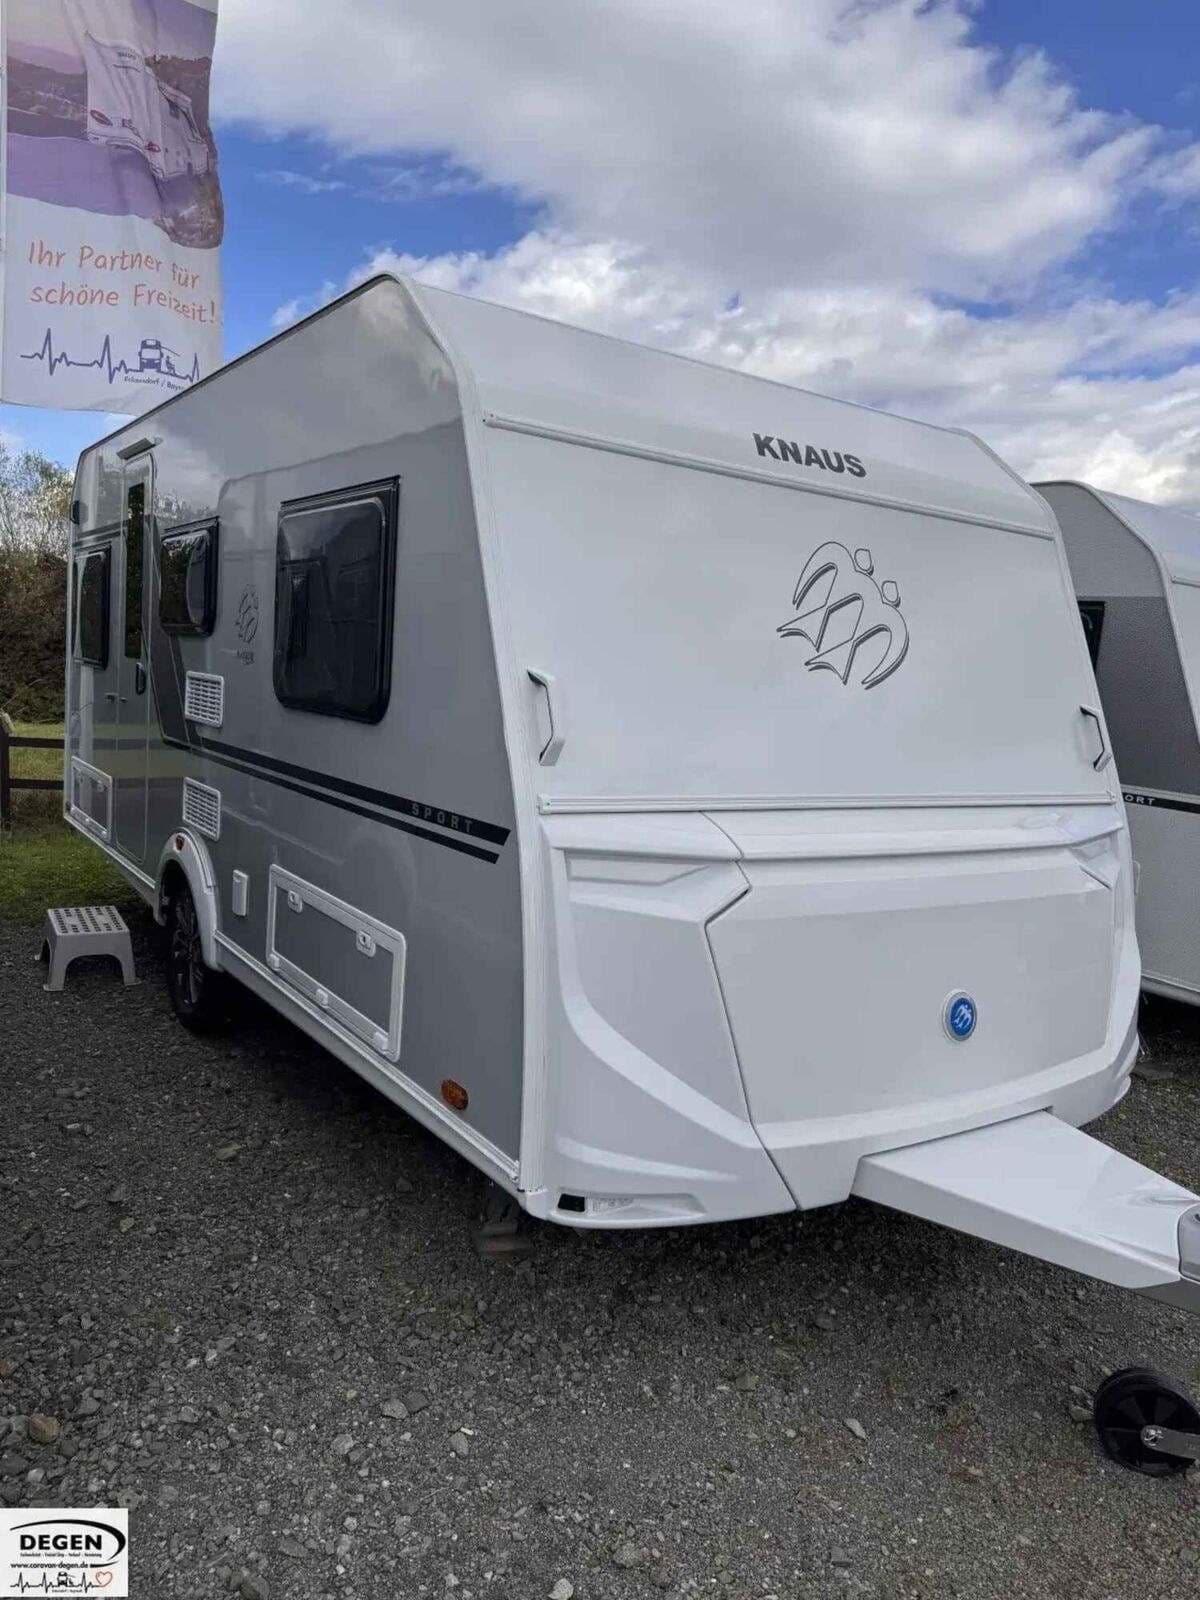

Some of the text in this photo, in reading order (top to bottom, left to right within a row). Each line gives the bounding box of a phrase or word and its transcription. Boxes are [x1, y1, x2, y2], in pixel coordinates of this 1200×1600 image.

[28, 240, 200, 289] Ihr Partner für
[30, 281, 215, 324] schöne Freizeit!
[752, 432, 867, 478] KNAUS
[411, 802, 474, 833] SPORT
